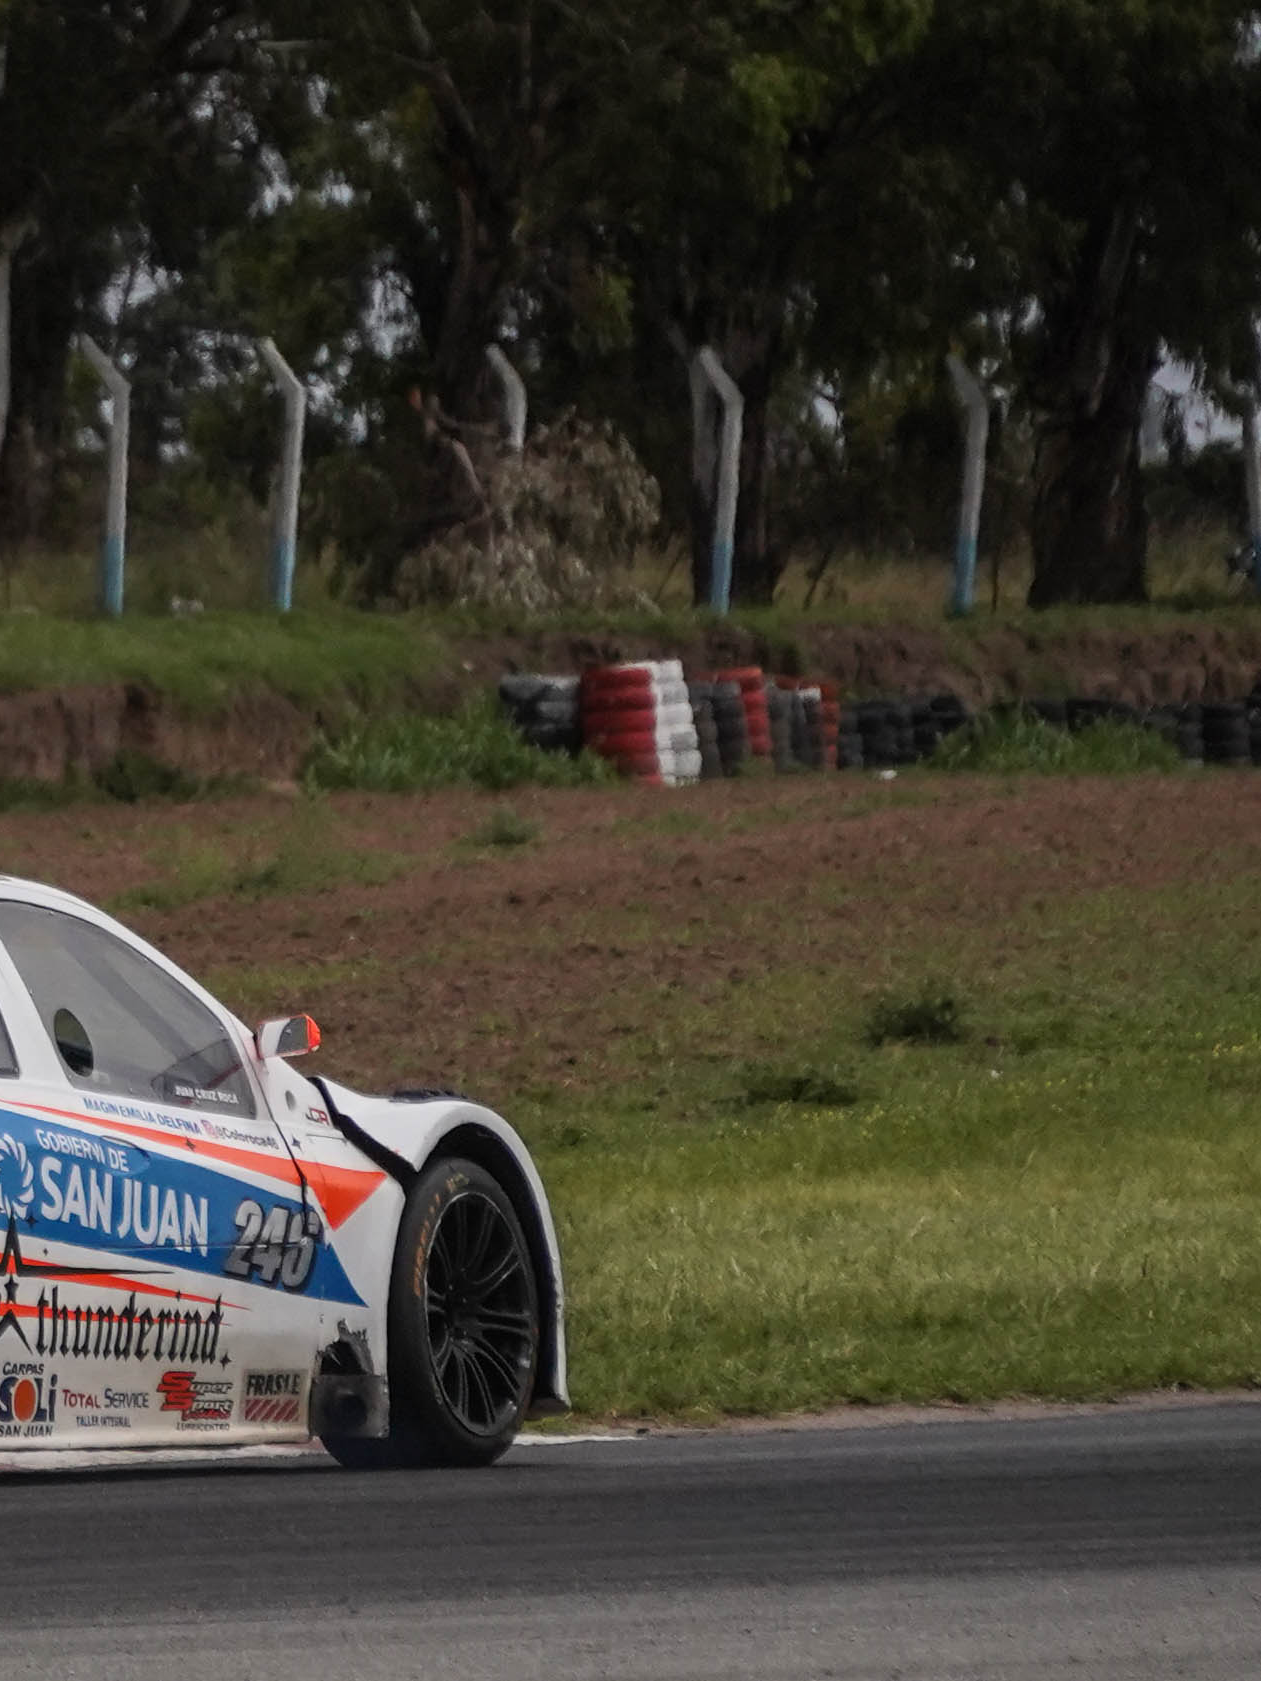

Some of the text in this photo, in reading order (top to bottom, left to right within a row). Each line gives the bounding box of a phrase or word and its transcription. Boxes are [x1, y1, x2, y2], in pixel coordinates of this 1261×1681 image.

[108, 1147, 130, 1172] DE
[40, 1156, 209, 1258] SAN JUAN
[224, 1198, 321, 1289] 246
[2, 1361, 45, 1376] CARPAS
[62, 1387, 150, 1409] TOTAL SERVICE
[24, 1424, 54, 1438] JUAN
